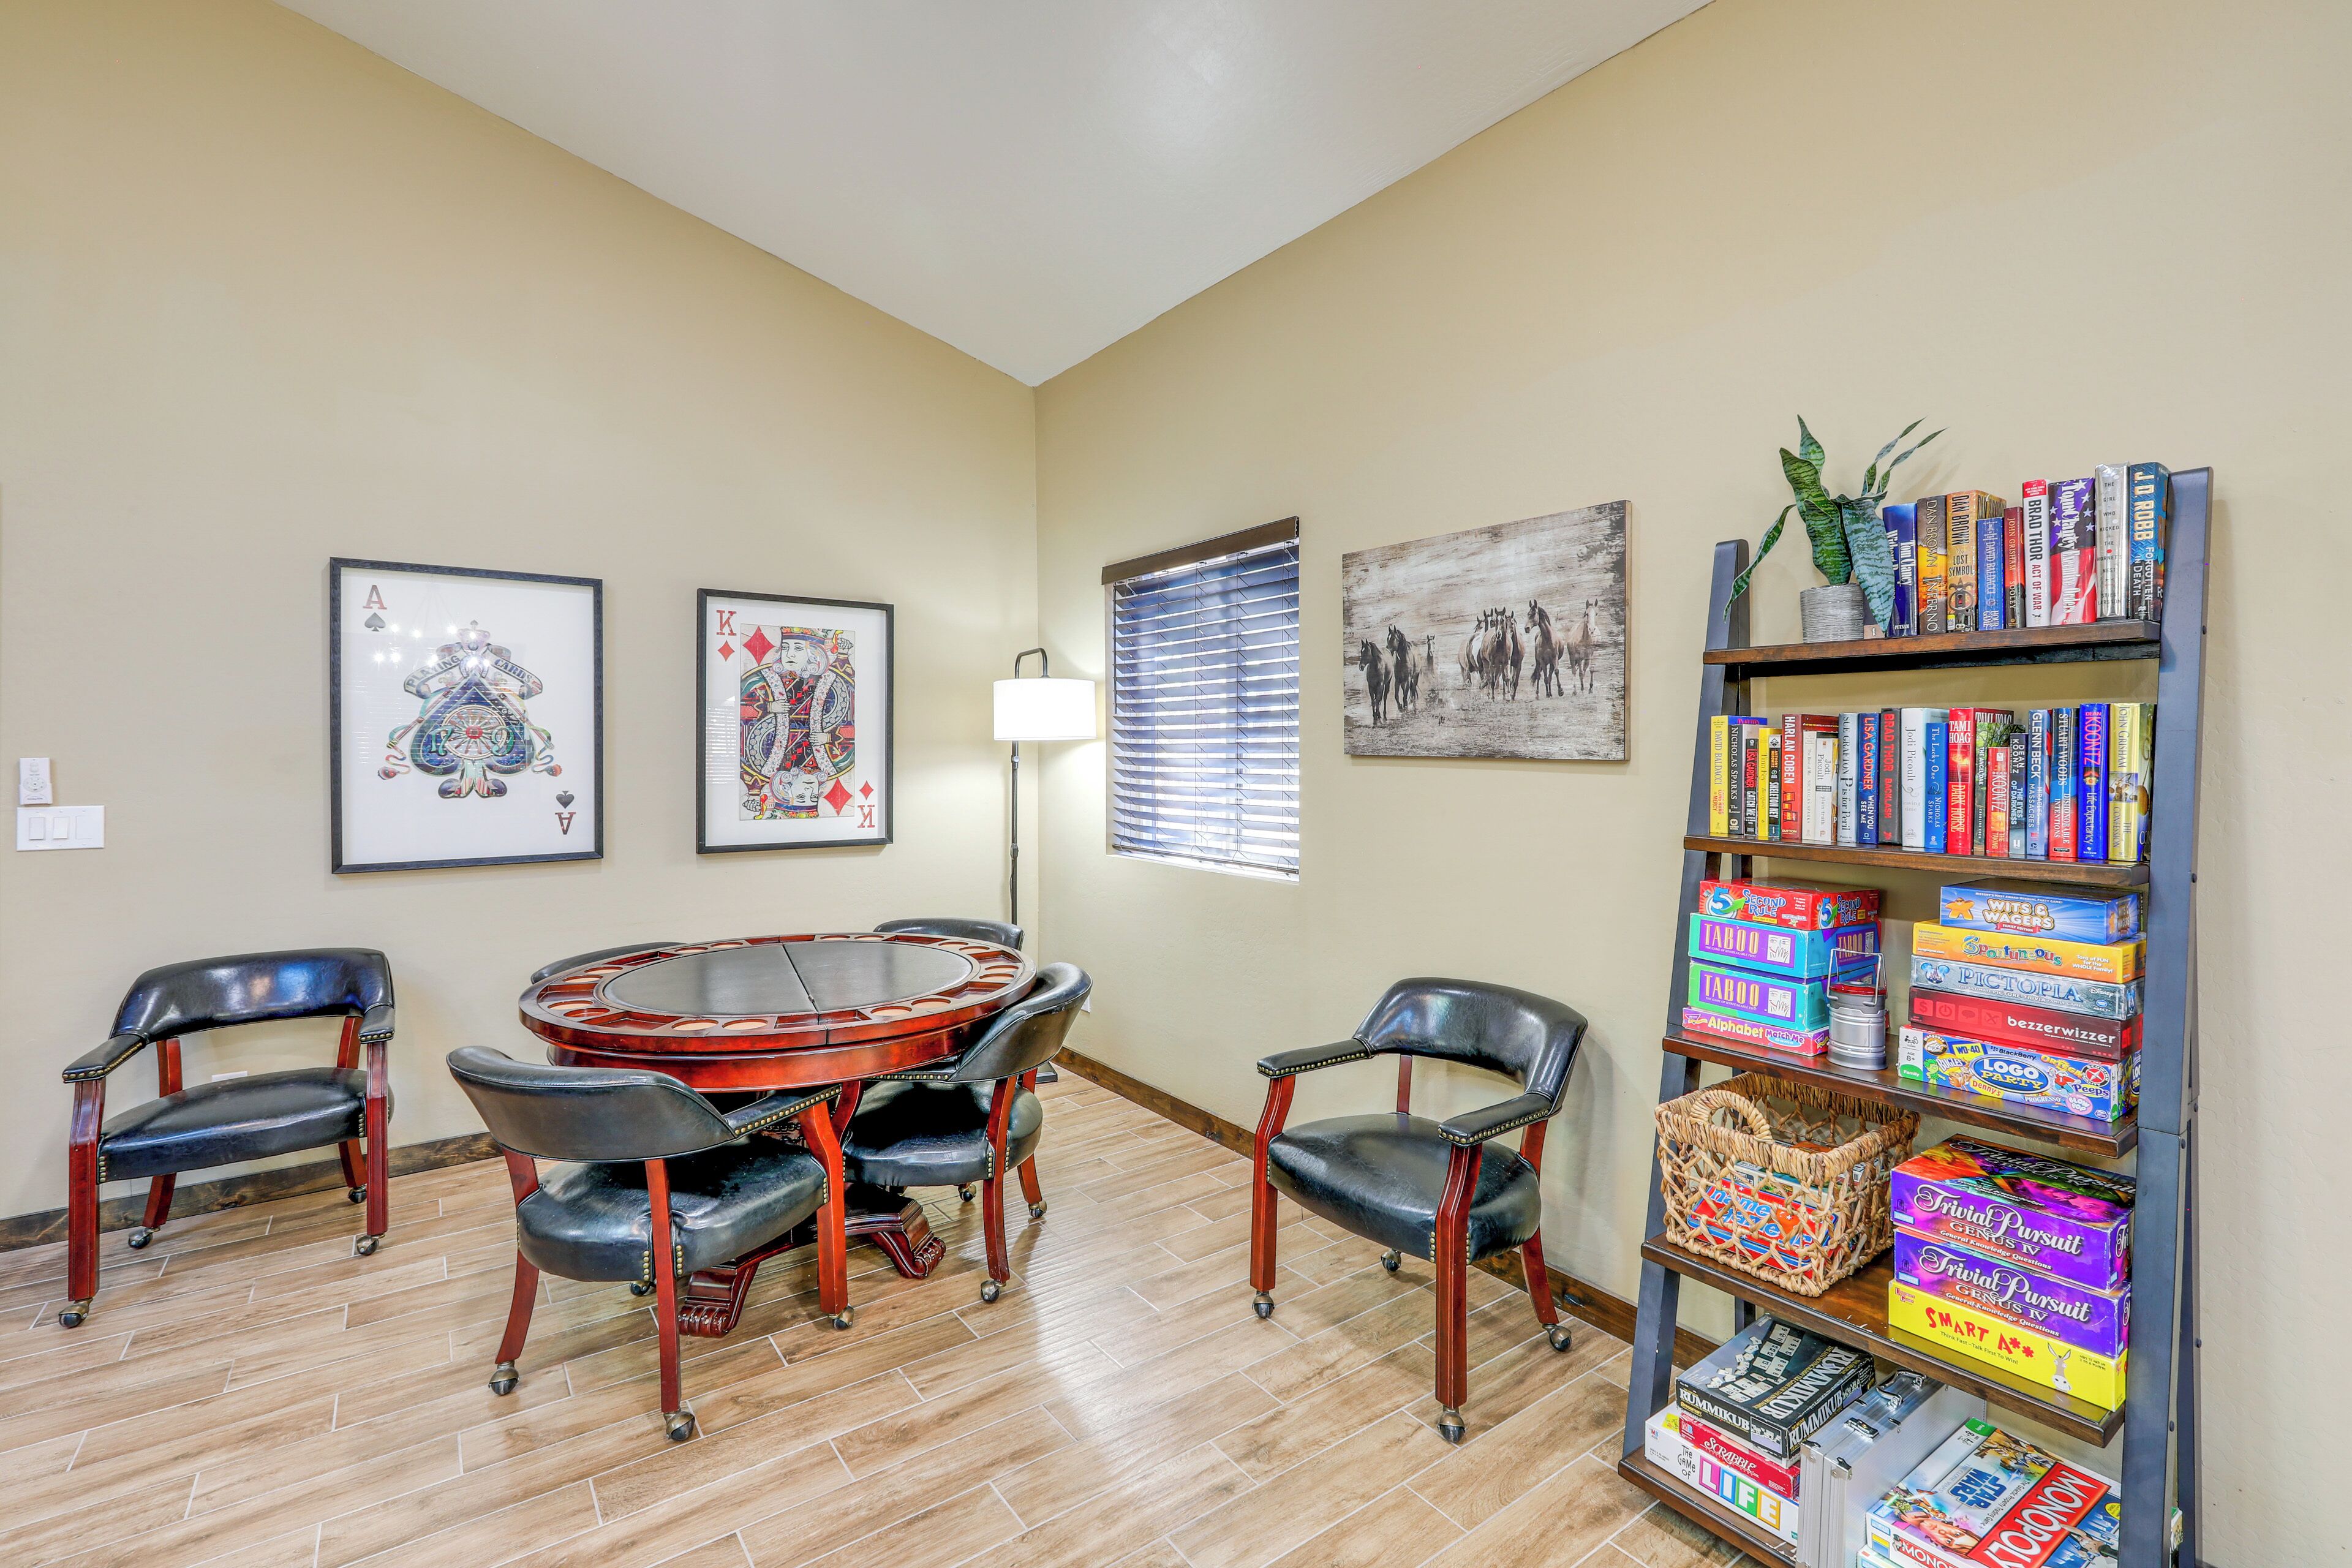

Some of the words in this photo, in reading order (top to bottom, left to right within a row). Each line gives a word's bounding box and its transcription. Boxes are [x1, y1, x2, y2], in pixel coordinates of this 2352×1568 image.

[2134, 472, 2155, 484] J.
[1952, 495, 1970, 513] DAN
[2134, 486, 2154, 498] D.
[1926, 500, 1937, 525] DAN
[2029, 499, 2041, 529] BRAD
[2134, 500, 2155, 541] ROBB
[1951, 514, 1969, 546] BROWN
[1926, 527, 1938, 567] BROWN
[1986, 541, 1996, 565] DAVID
[2029, 530, 2043, 561] THOR
[1949, 565, 1973, 577] SYMBOL
[1953, 554, 1968, 565] LOST
[2032, 565, 2041, 578] ACT
[2135, 555, 2141, 565] IN
[1986, 565, 1996, 594] BALDACCI
[2032, 580, 2041, 590] OF
[2133, 565, 2143, 597] DEATH
[2145, 547, 2154, 600] FORGOTTEN
[363, 584, 388, 610] A
[1923, 575, 1941, 631] INFERNO
[2033, 593, 2041, 610] WAR
[716, 609, 737, 636] K
[1990, 610, 1999, 627] HOUR
[406, 654, 461, 690] PLAYING
[494, 657, 533, 684] CARDS
[1864, 717, 1874, 732] LISA
[1883, 714, 1894, 742] BRAD
[1949, 721, 1971, 732] TAMI
[2032, 712, 2042, 749] GLENN
[2119, 706, 2130, 728] JOHN
[1785, 716, 1795, 752] HARLAN
[1905, 726, 1916, 747] Jodi
[1931, 727, 1940, 741] The
[1949, 733, 1971, 744] HOAG
[2059, 714, 2068, 748] STUART
[2083, 717, 2101, 766] KOONTZ
[1883, 744, 1894, 772] THOR
[1929, 743, 1939, 763] Lucky
[2118, 730, 2130, 768] GRISHAM
[1784, 755, 1795, 784] COBEN
[1863, 742, 1874, 790] GARDNER
[1907, 749, 1916, 782] Picoult
[1931, 765, 1940, 780] One
[2031, 750, 2042, 779] BECK
[2058, 750, 2068, 786] WOODS
[1840, 777, 1853, 787] P
[1951, 785, 1966, 805] DARK
[1991, 775, 2007, 812] KOONTZ
[2011, 780, 2018, 790] OF
[1883, 778, 1893, 819] BACKLASH
[554, 811, 577, 835] A
[857, 804, 876, 829] K
[1842, 811, 1850, 831] Peril
[1860, 815, 1866, 824] ME
[1950, 806, 1965, 832] HORSE
[1711, 887, 1728, 914] 5
[1742, 889, 1786, 907] SECOND
[1749, 905, 1777, 917] RULE
[1822, 897, 1831, 922] 5
[1837, 895, 1861, 911] SECOND
[1988, 899, 2030, 915] WITS
[2034, 903, 2048, 916] &
[1840, 911, 1856, 924] RULE
[1983, 910, 2054, 929] WAGERS
[1704, 924, 1759, 954] TABOO
[1839, 933, 1862, 959] TABOO
[1704, 974, 1760, 1007] TABOO
[1959, 967, 2083, 1003] PICTOPIA
[1707, 1016, 1764, 1038] Alphabet
[1765, 1029, 1791, 1041] Match
[1791, 1035, 1805, 1044] Me
[2007, 1016, 2116, 1044] bezzerwizzer
[1956, 1046, 1980, 1054] WD-40
[1980, 1070, 2045, 1090] PARTY
[1983, 1058, 2040, 1079] LOGO
[2040, 1054, 2082, 1079] ORTEGA
[1972, 1080, 2001, 1096] Denny's
[2072, 1084, 2109, 1098] Peeps
[1913, 1183, 1994, 1230] Trivial
[1984, 1203, 2084, 1254] Pursuit
[1950, 1219, 2017, 1248] GENUS
[2021, 1243, 2041, 1256] IV
[1918, 1245, 1999, 1292] Trivial
[1989, 1268, 2090, 1322] Pursuit
[1925, 1306, 1989, 1343] SMART
[1940, 1330, 1956, 1341] Think
[1984, 1347, 1997, 1358] First
[2005, 1353, 2019, 1365] Win!
[1760, 1346, 1858, 1420] RUMMIKUB
[1679, 1389, 1750, 1431] RUMMIKUB
[1789, 1390, 1844, 1447] RUMMIKUB
[1704, 1437, 1757, 1474] SCRABBLE
[1682, 1469, 1691, 1480] OF
[1950, 1469, 1993, 1502] WARS
[1702, 1460, 1777, 1525] LIFE
[1966, 1476, 2007, 1509] STAR
[1983, 1469, 2098, 1568] MONOPOLY
